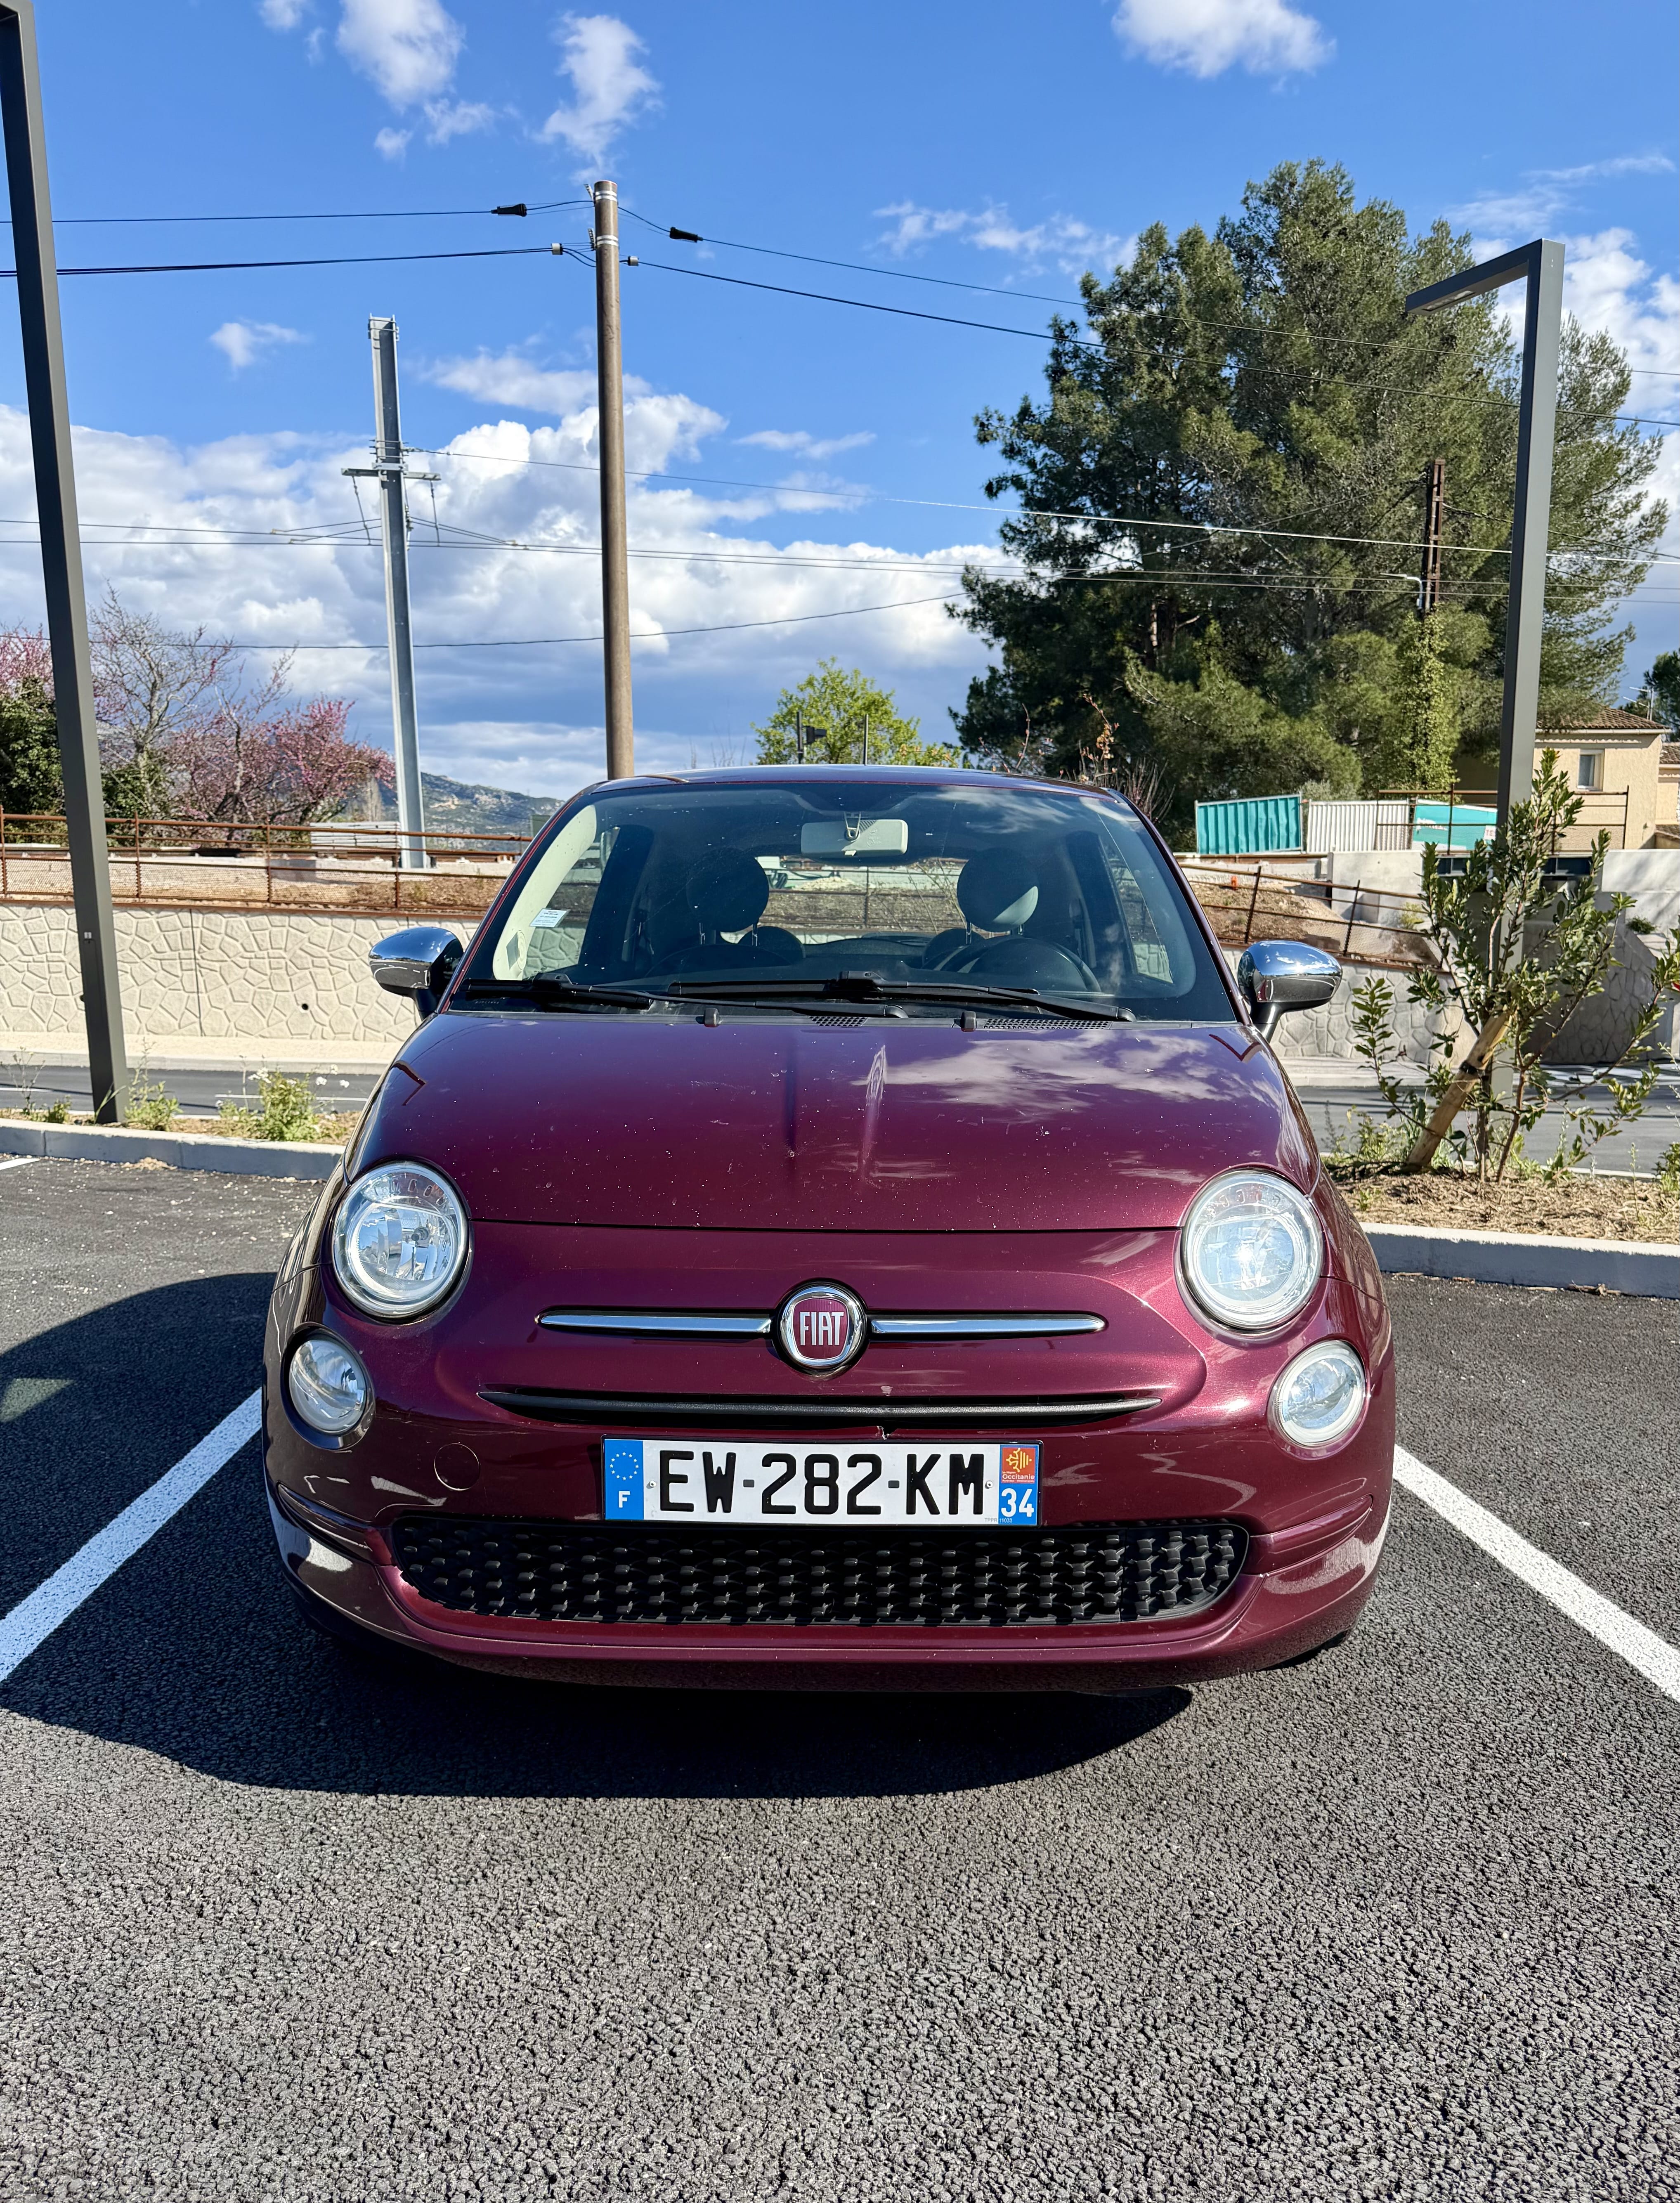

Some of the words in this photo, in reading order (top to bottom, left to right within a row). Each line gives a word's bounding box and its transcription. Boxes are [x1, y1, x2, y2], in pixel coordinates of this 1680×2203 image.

[800, 1312, 844, 1345] FIAT
[659, 1450, 984, 1515] EW-282-KM
[619, 1491, 631, 1508] F
[1001, 1488, 1034, 1517] 34
